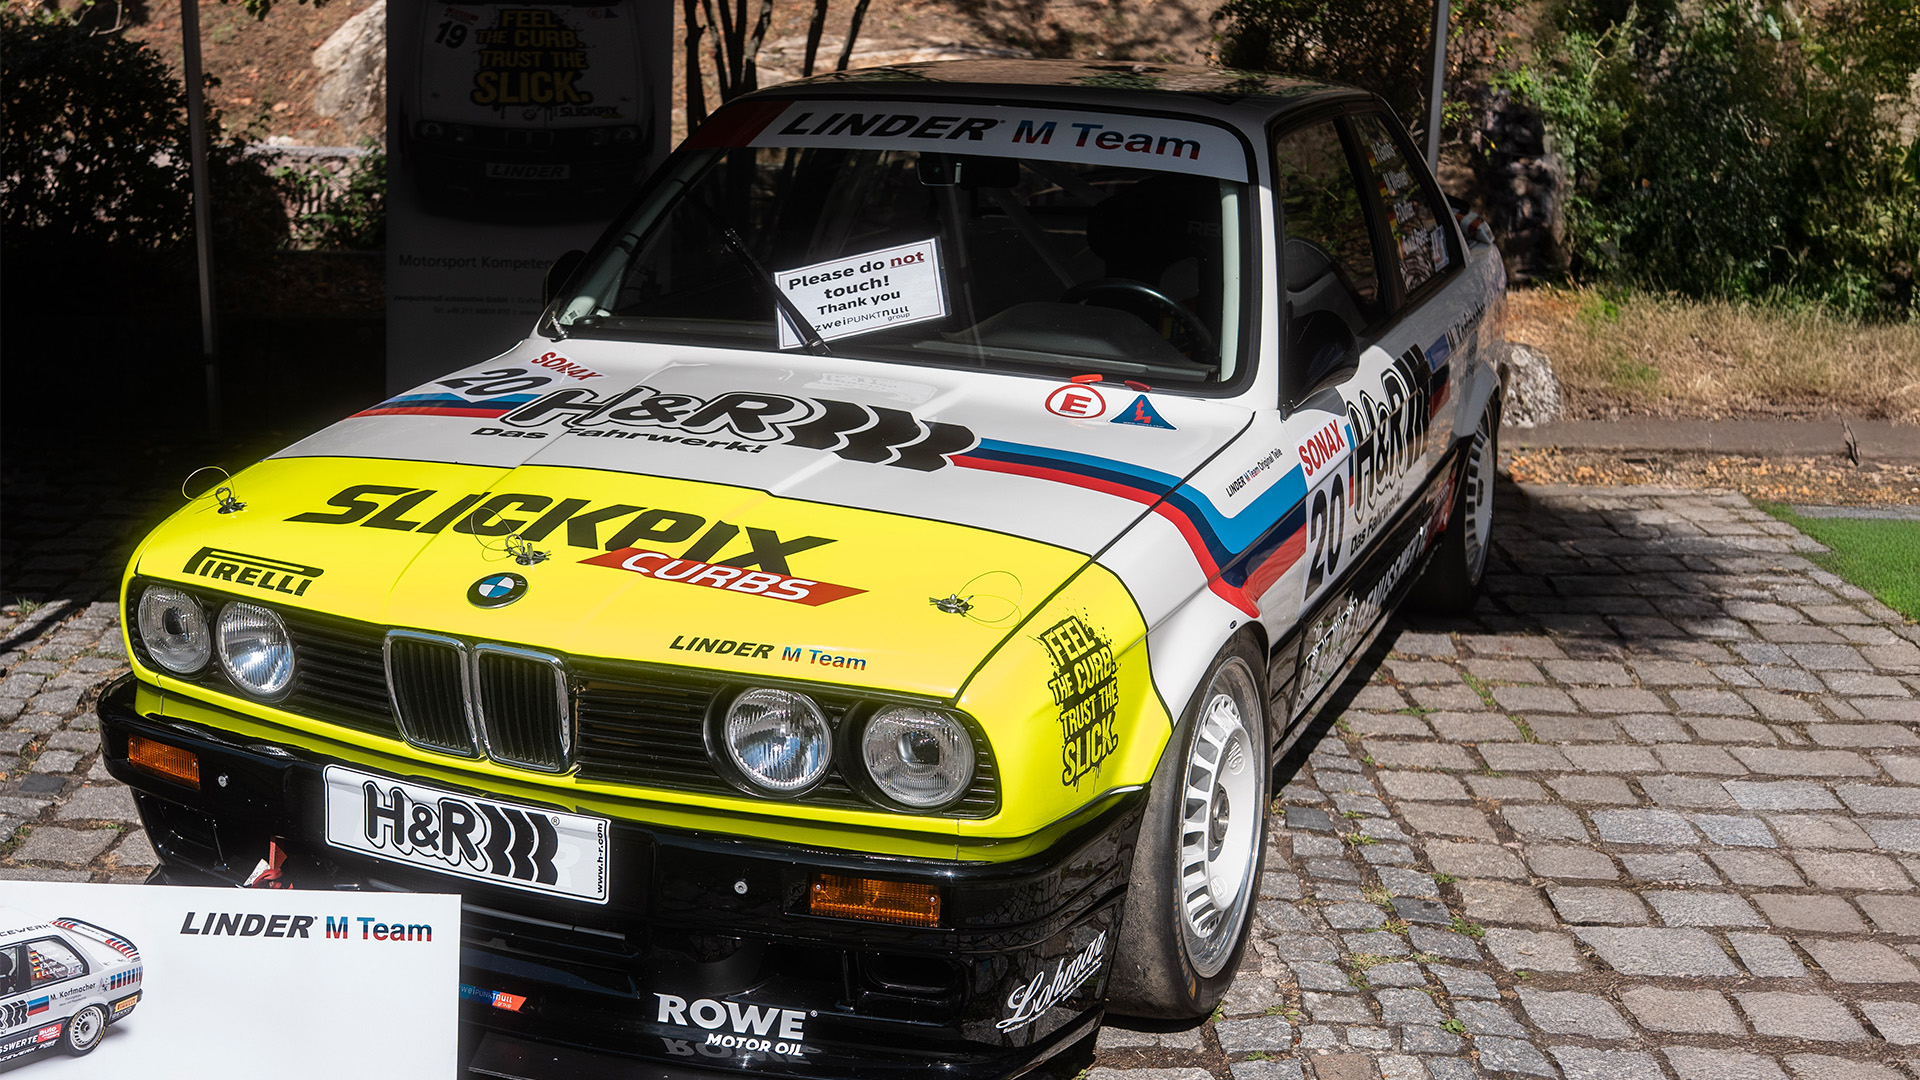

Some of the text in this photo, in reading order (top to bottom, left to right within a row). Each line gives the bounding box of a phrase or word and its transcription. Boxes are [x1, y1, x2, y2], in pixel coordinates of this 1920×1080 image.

[435, 21, 467, 49] 19
[502, 9, 557, 28] FEEL
[477, 29, 586, 48] THE CURB.
[480, 50, 588, 69] TRUST THE
[474, 71, 592, 103] SLICK.
[778, 112, 1201, 161] LINDER M Team
[491, 165, 564, 178] LINDER
[399, 254, 477, 269] Motorsport
[788, 251, 925, 290] Please do not
[817, 290, 901, 315] Thank you
[824, 275, 890, 299] touch!
[888, 312, 911, 322] group
[434, 368, 552, 396] 20
[531, 351, 603, 381] SONAX
[500, 385, 813, 443] H&R
[471, 427, 768, 454] Das Fahrwerk!
[1298, 419, 1345, 477] SONAX
[1346, 368, 1408, 525] H&R
[1225, 475, 1246, 498] LINDER
[1247, 466, 1261, 479] Team
[284, 484, 837, 575] SLICKPIX
[1305, 473, 1344, 600] 20
[1350, 528, 1367, 557] Das
[182, 546, 325, 597] PIRELLI
[620, 551, 818, 601] CURBS
[670, 635, 866, 671] LINDER M Team
[1043, 618, 1096, 667] FEEL
[1049, 646, 1117, 702] THE CURB.
[1061, 678, 1119, 739] TRUST THE
[1063, 712, 1117, 784] SLICK.
[363, 780, 488, 872] H&R
[596, 822, 604, 893] www.h-r.com
[180, 912, 432, 942] LINDER M Team
[995, 930, 1106, 1029] Lohmar
[705, 1033, 772, 1053] MOTOR
[774, 1042, 804, 1057] OIL
